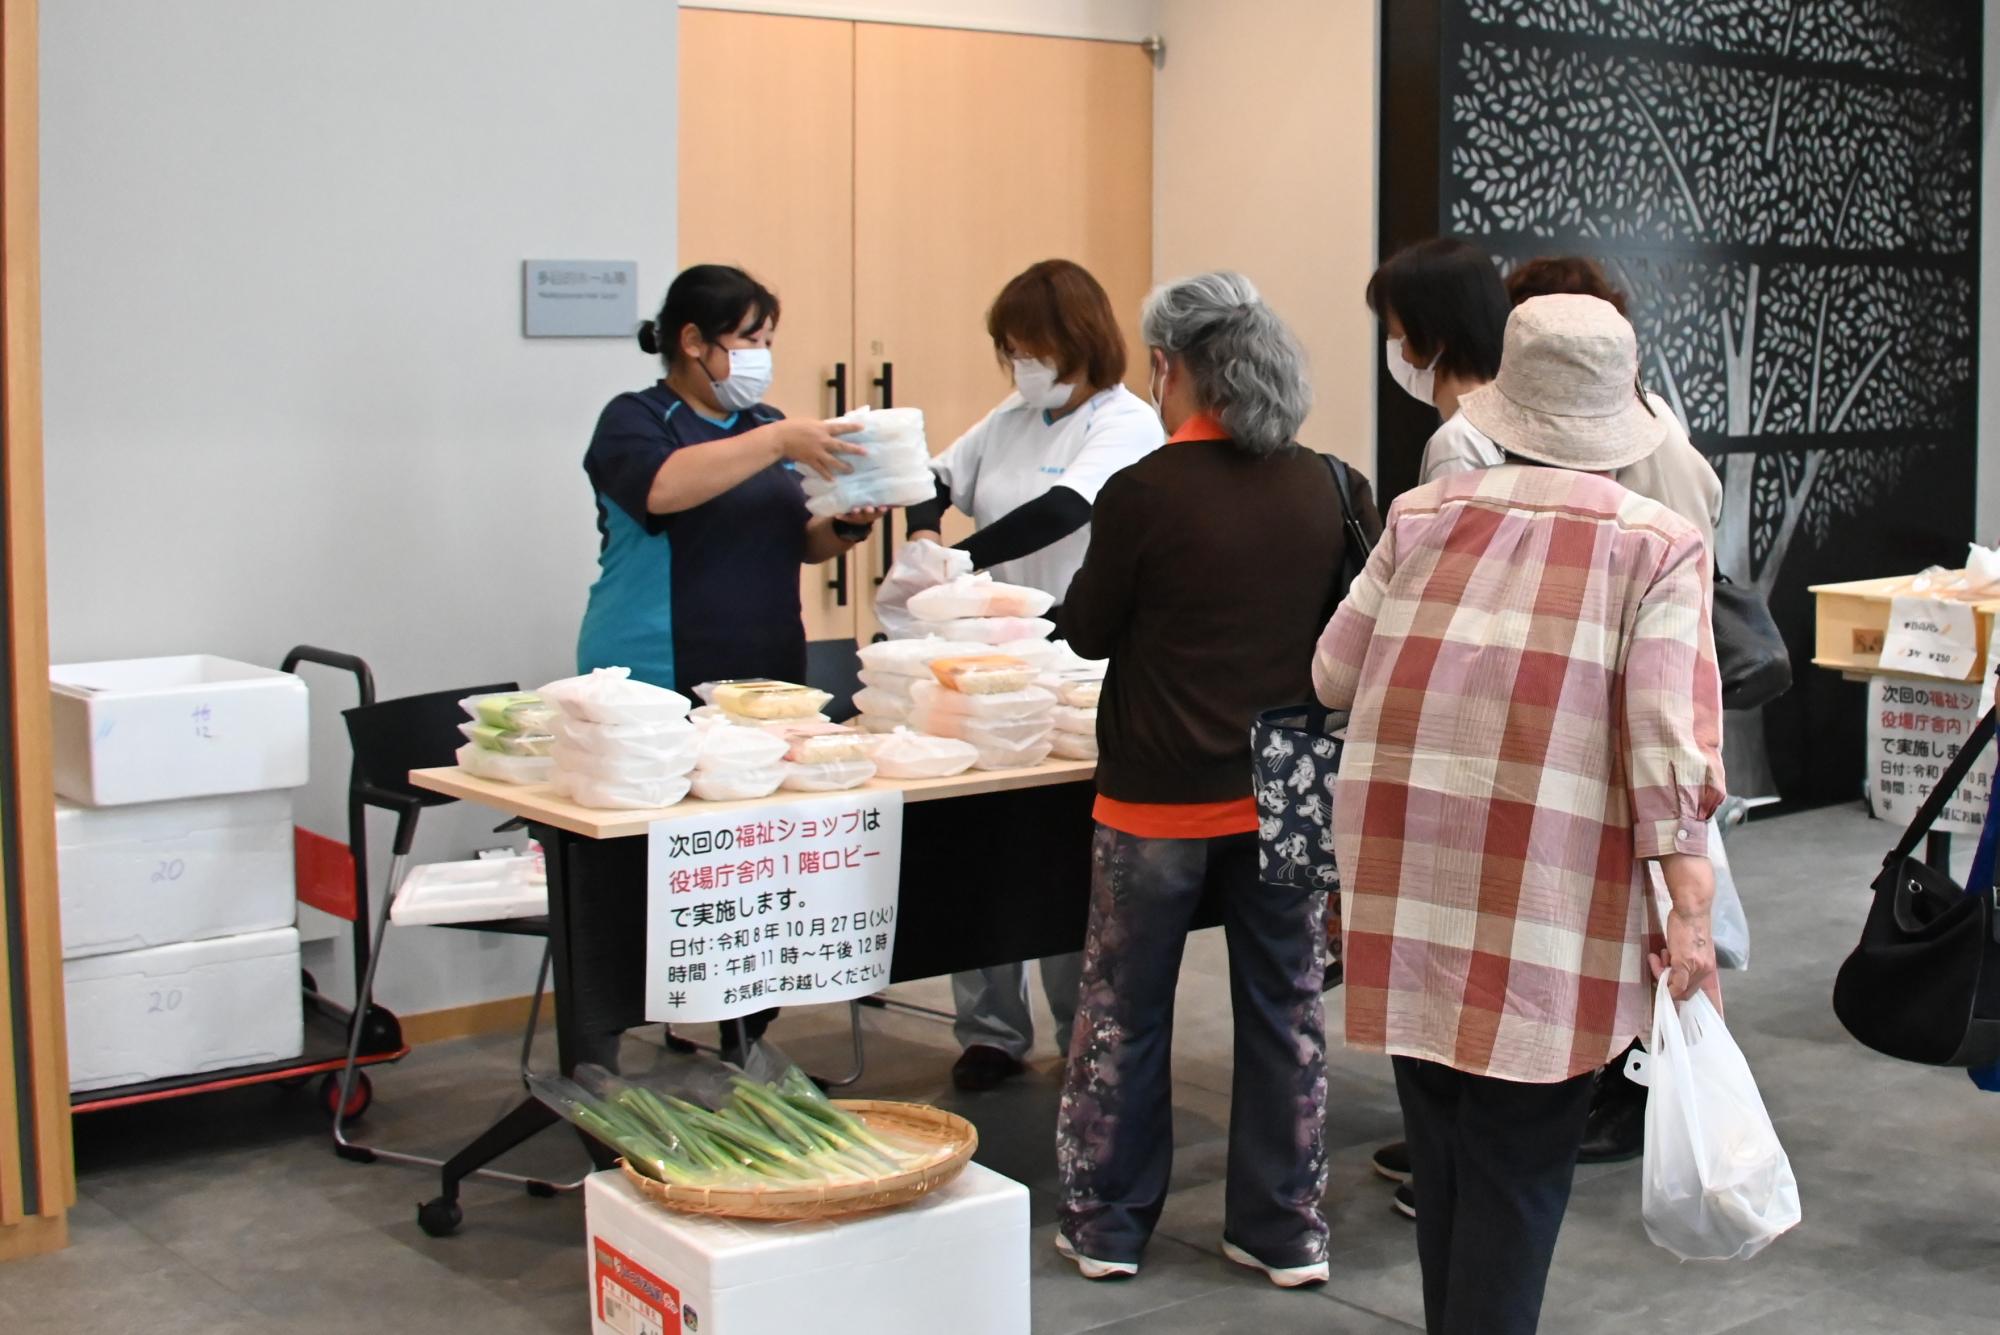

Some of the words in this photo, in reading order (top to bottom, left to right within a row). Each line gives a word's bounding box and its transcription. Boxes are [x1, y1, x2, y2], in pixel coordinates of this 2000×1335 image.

[1882, 685, 1980, 710] 次回の福祉シ
[669, 808, 880, 858] 次回の福祉ショップは
[151, 859, 186, 883] 20
[669, 844, 880, 894] 役場庁舎内1階ロビー
[670, 887, 806, 927] で実施します。
[148, 989, 183, 1014] 20
[668, 990, 687, 1008] 半
